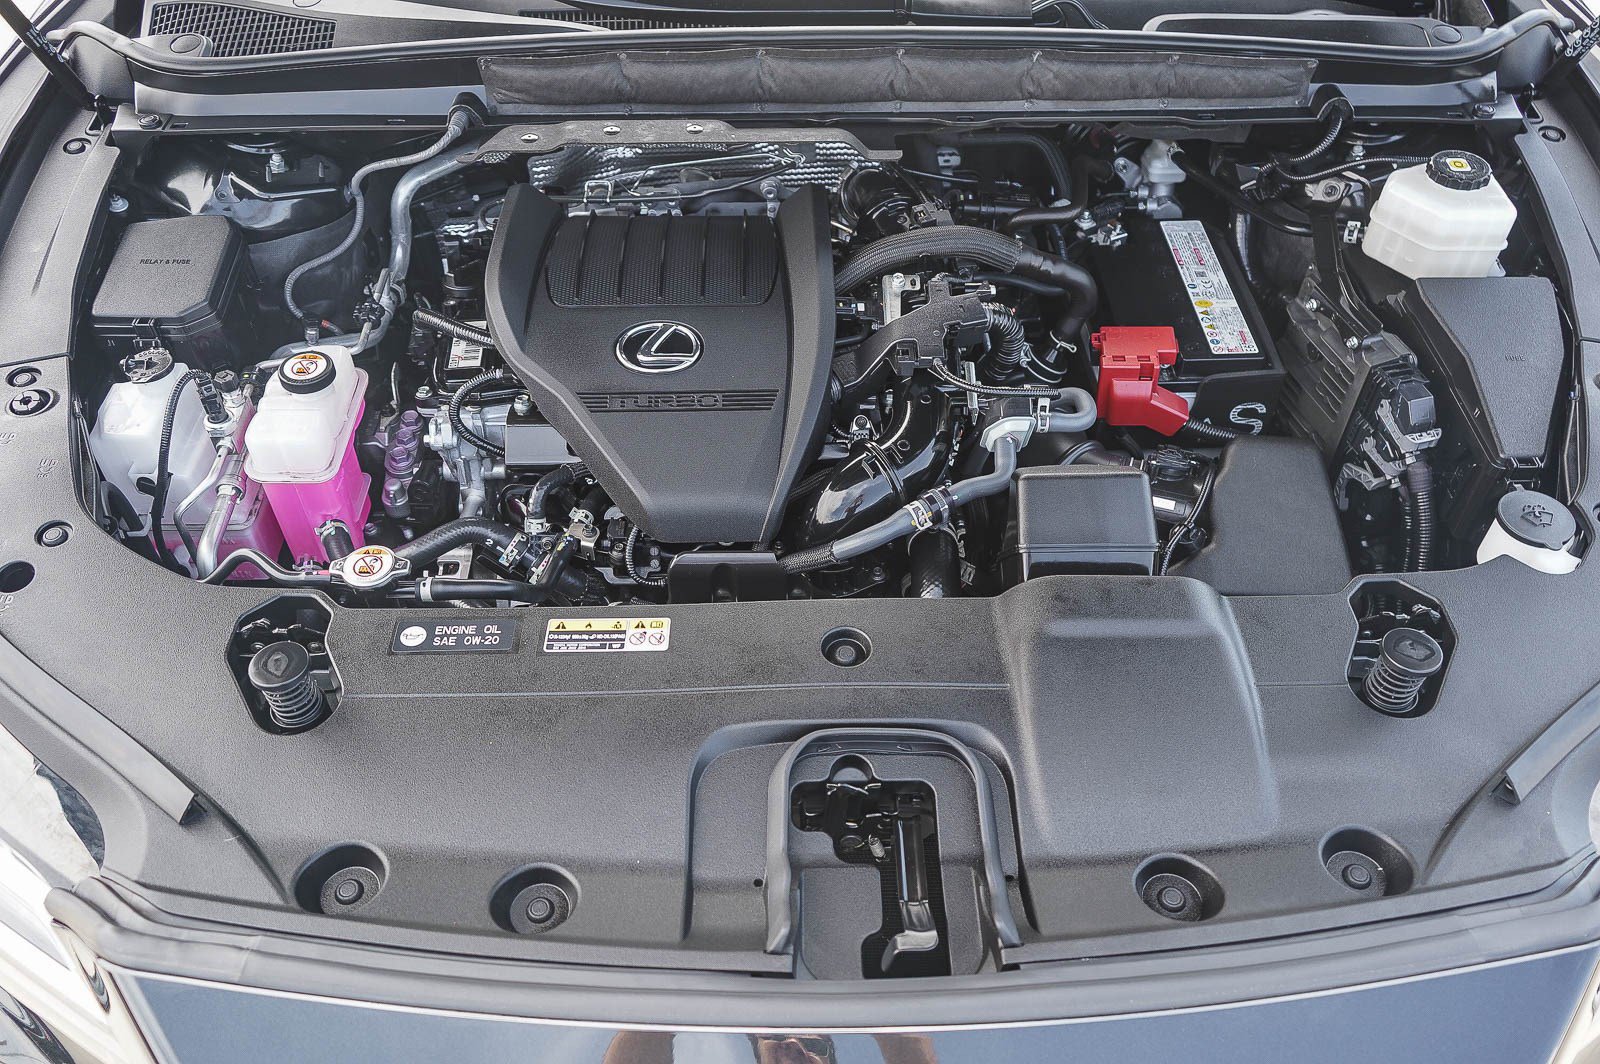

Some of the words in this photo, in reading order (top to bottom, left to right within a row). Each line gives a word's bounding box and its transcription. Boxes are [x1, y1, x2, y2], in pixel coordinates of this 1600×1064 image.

[608, 394, 720, 408] TURBO
[435, 625, 477, 635] ENGINE
[483, 624, 502, 634] OIL
[432, 636, 457, 646] SAE
[463, 635, 500, 645] 0W-20
